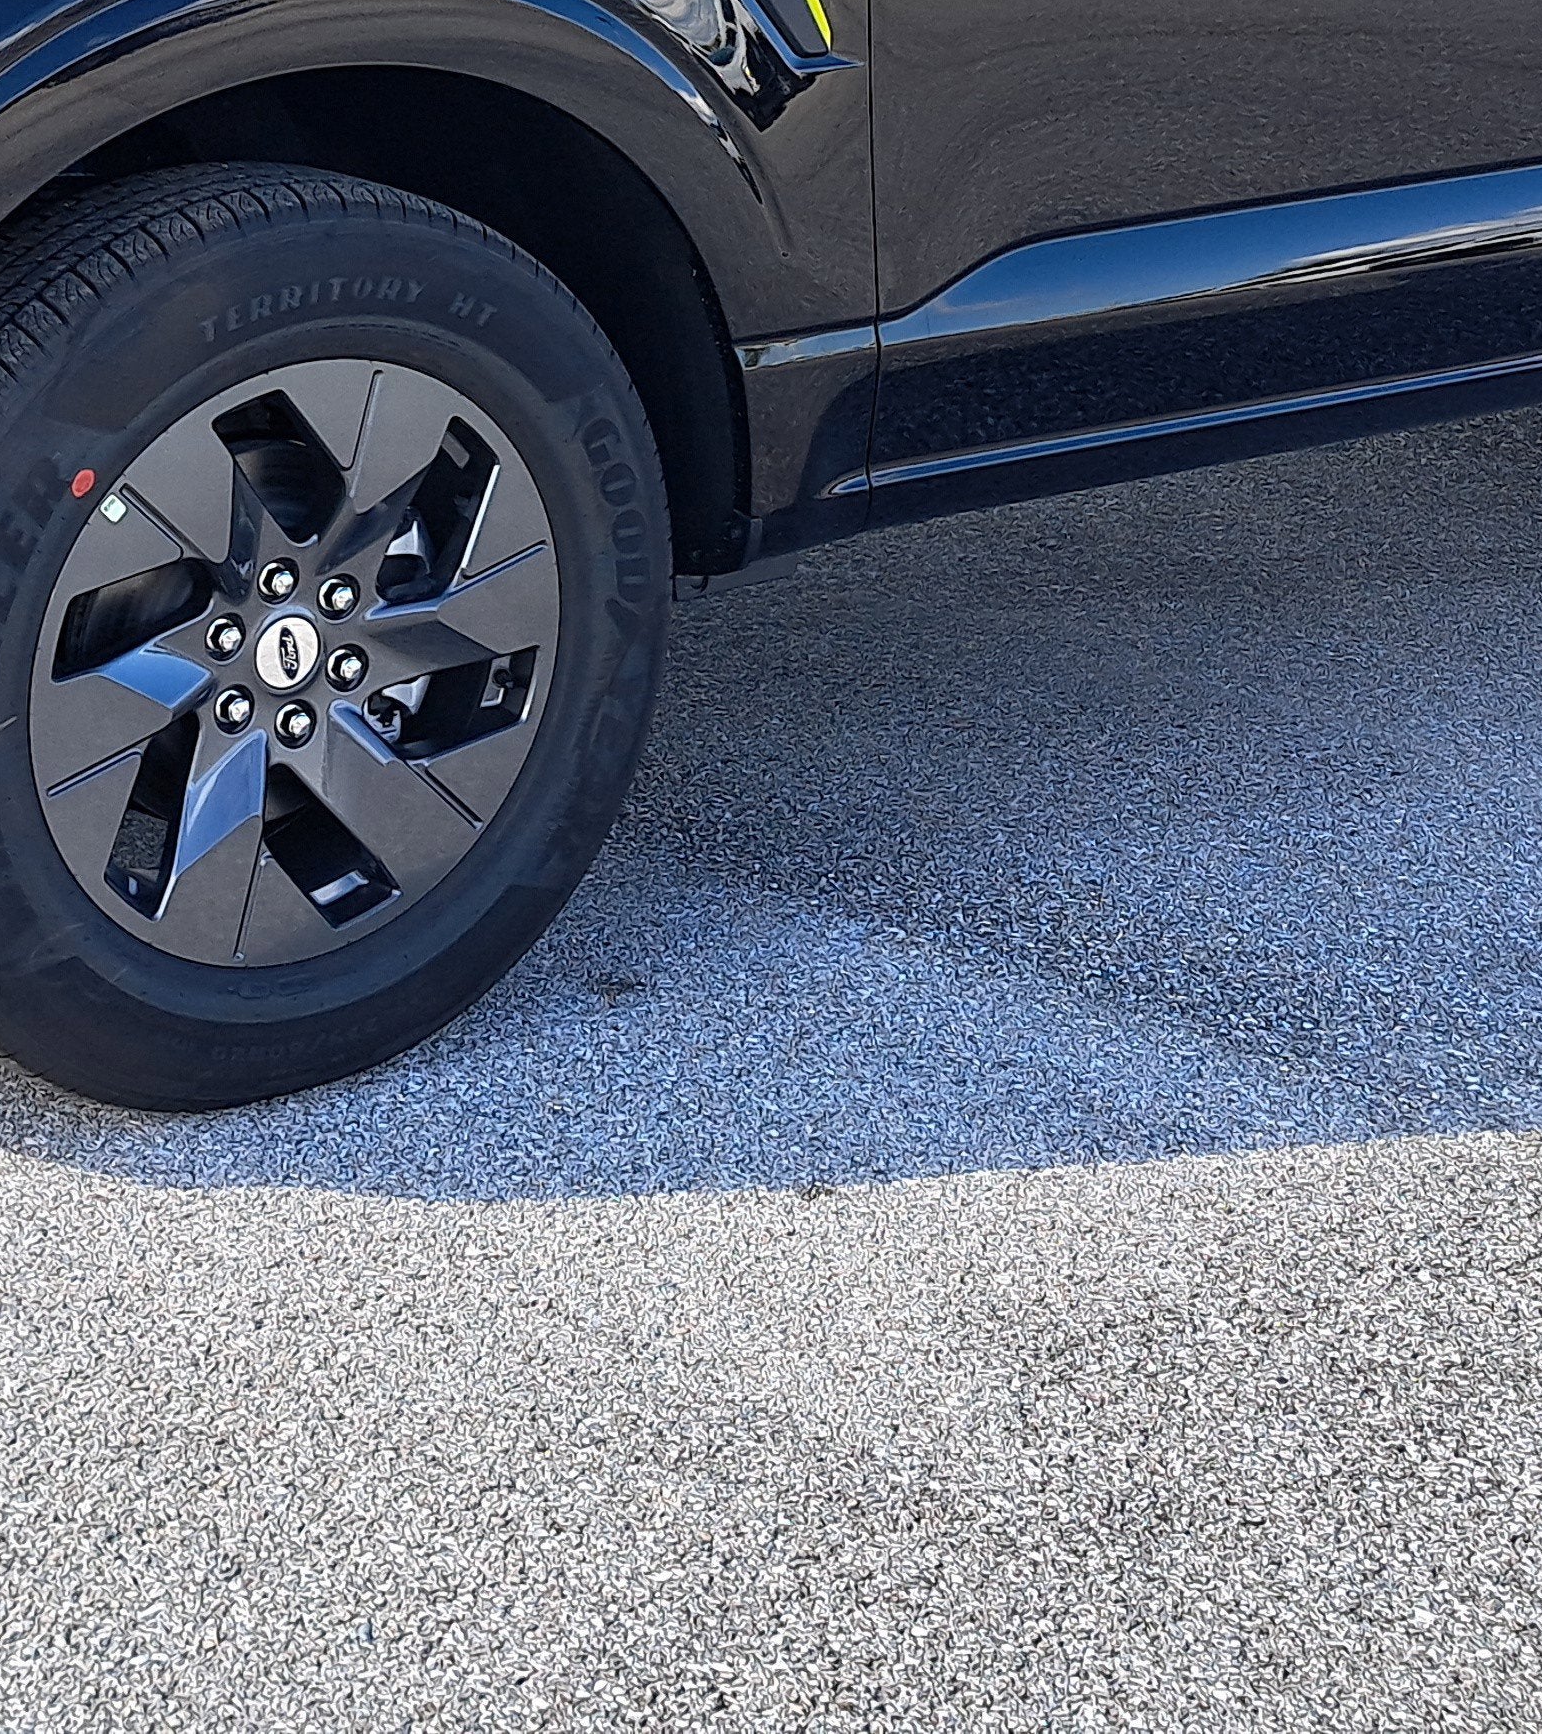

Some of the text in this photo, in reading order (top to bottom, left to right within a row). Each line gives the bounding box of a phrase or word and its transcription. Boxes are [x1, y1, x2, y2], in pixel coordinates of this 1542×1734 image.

[198, 276, 498, 343] TERRITORY HT
[280, 633, 299, 671] Ford
